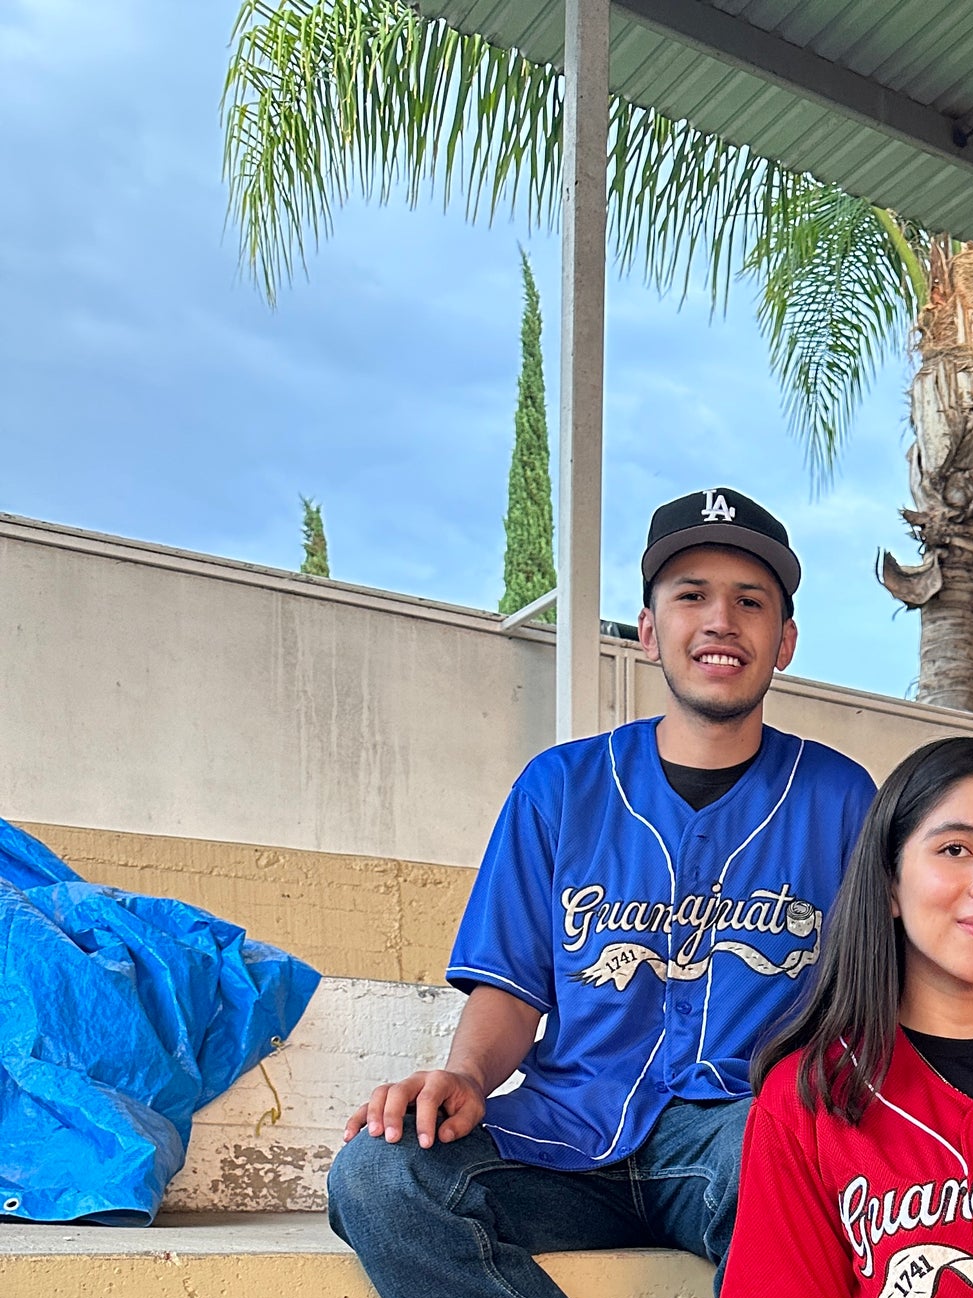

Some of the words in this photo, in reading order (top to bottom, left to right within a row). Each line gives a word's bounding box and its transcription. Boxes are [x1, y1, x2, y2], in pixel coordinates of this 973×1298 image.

[702, 490, 735, 521] LA
[606, 950, 637, 972] 1741
[894, 1255, 934, 1297] 1741
